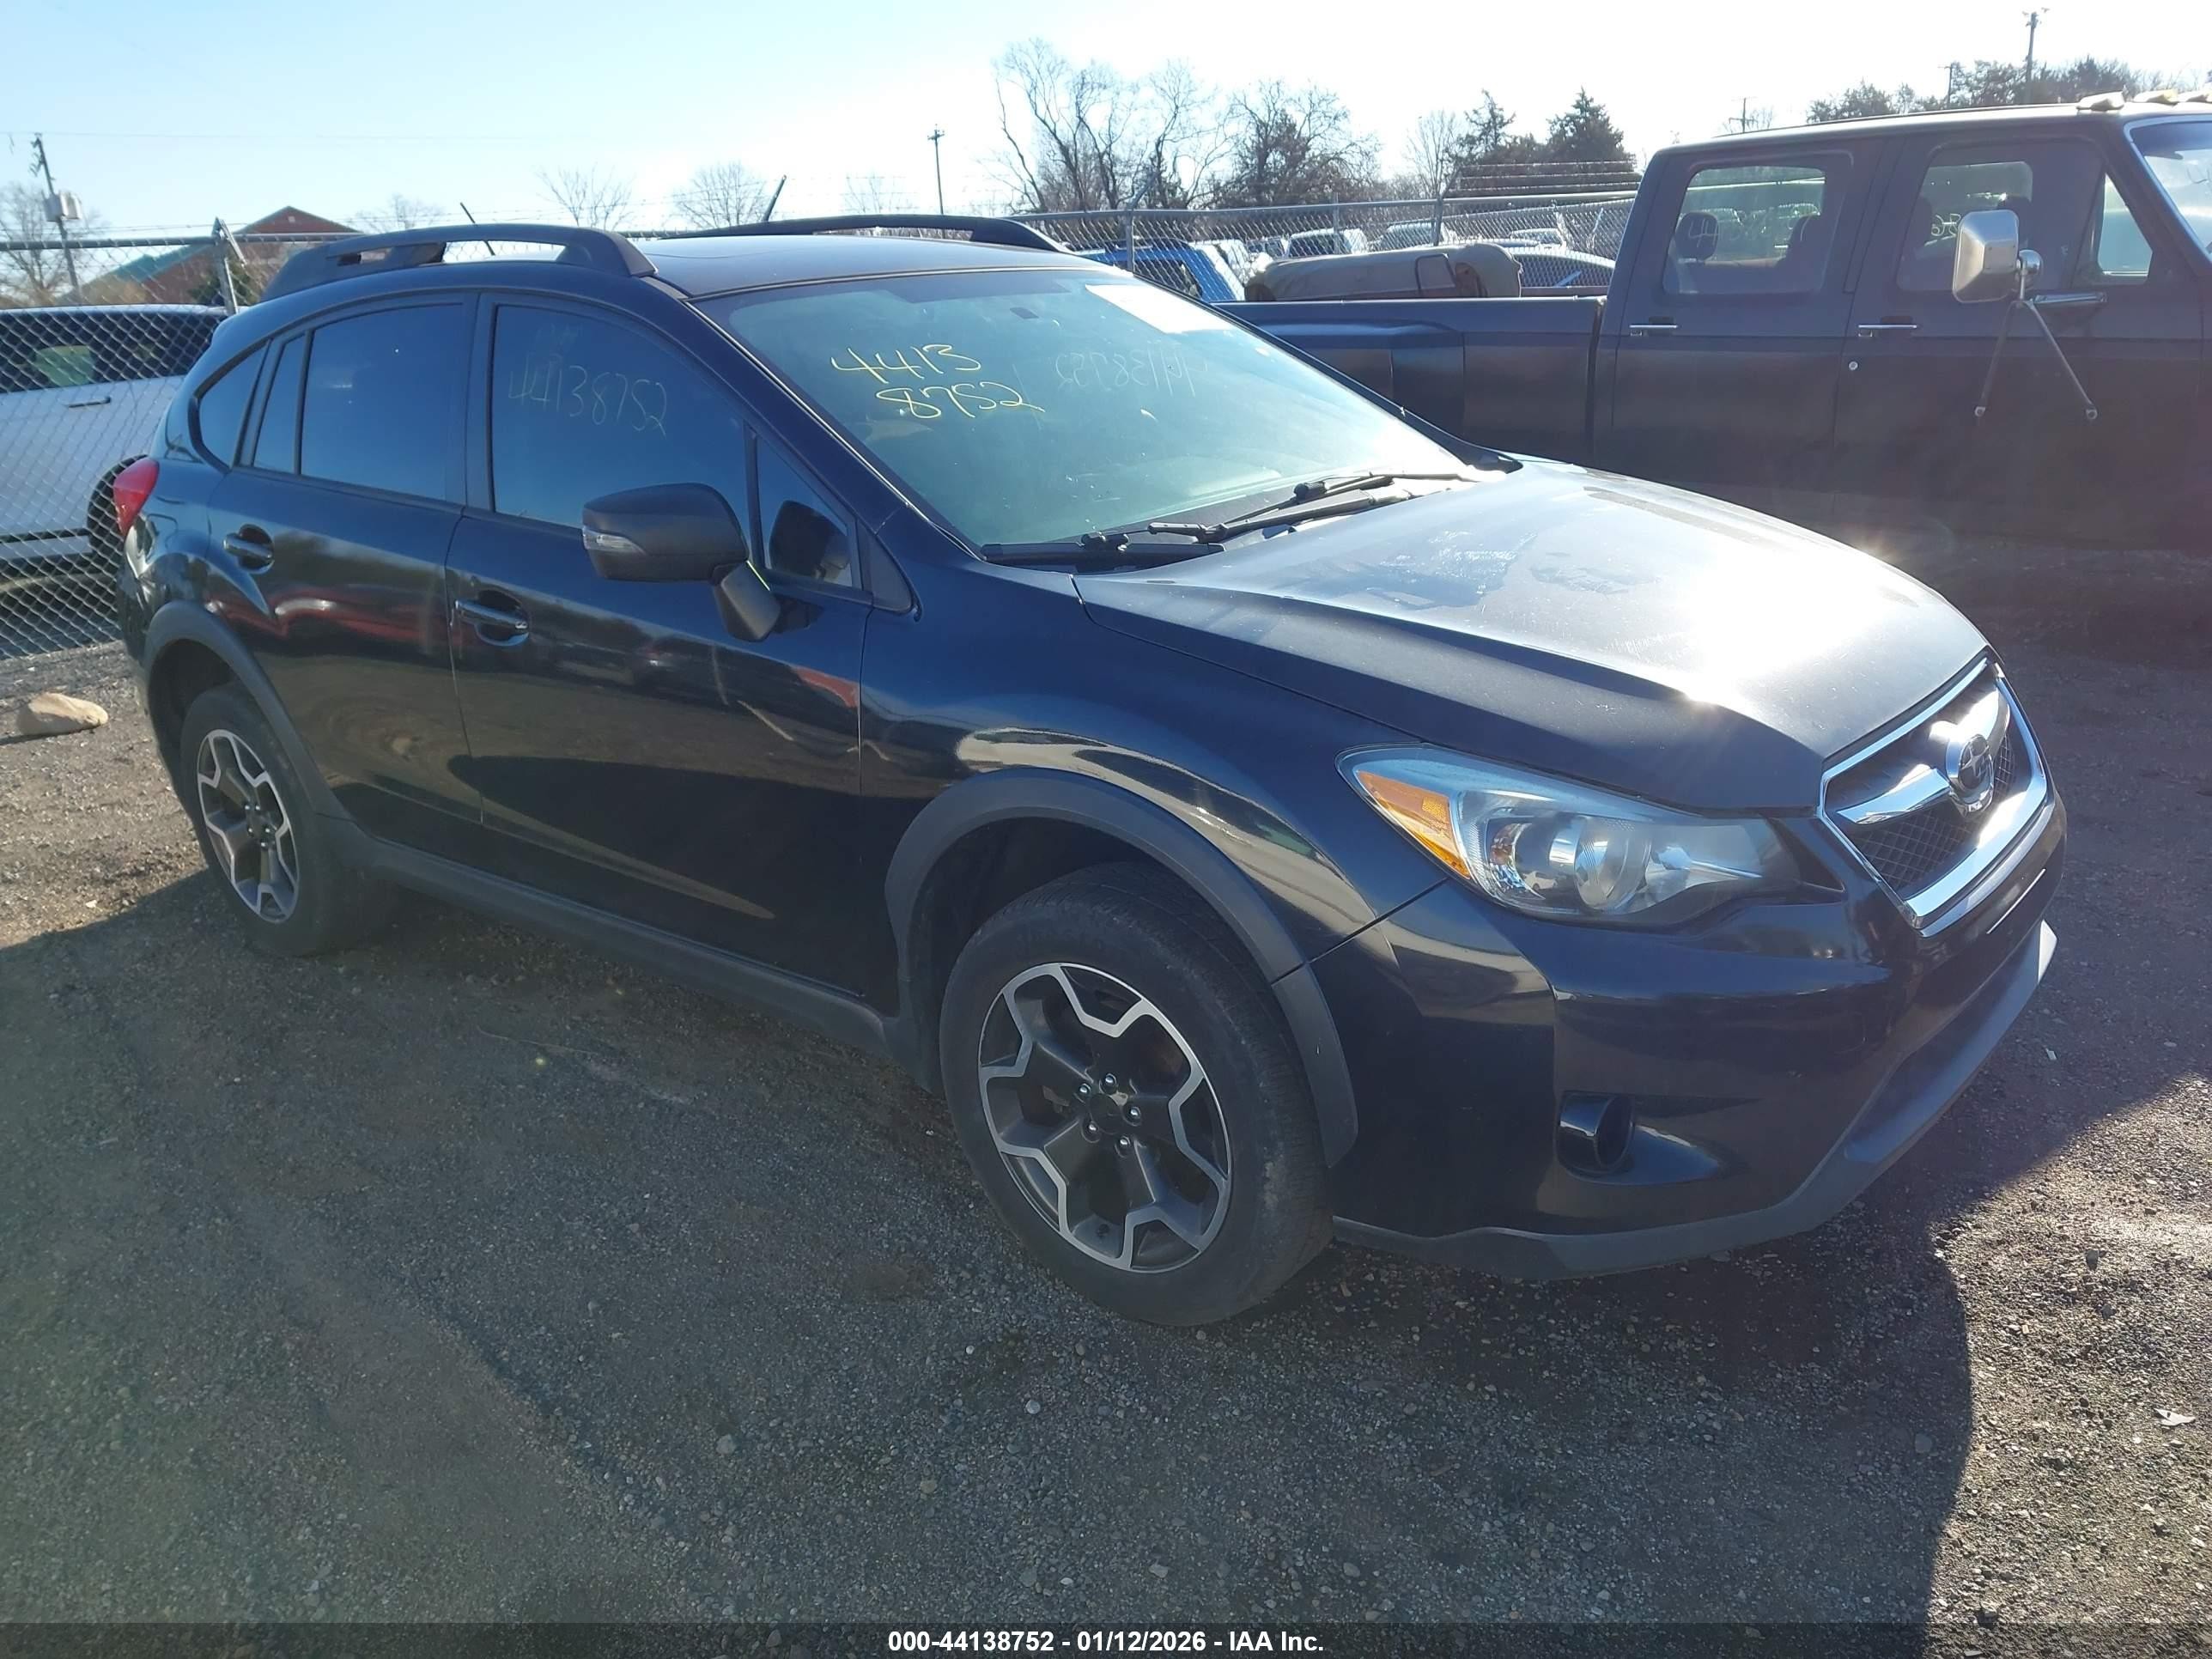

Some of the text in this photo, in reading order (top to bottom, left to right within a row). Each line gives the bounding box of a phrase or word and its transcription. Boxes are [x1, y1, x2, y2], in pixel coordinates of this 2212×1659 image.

[830, 343, 981, 384] 4413
[507, 352, 666, 440] 44138752
[875, 380, 1046, 419] 8752
